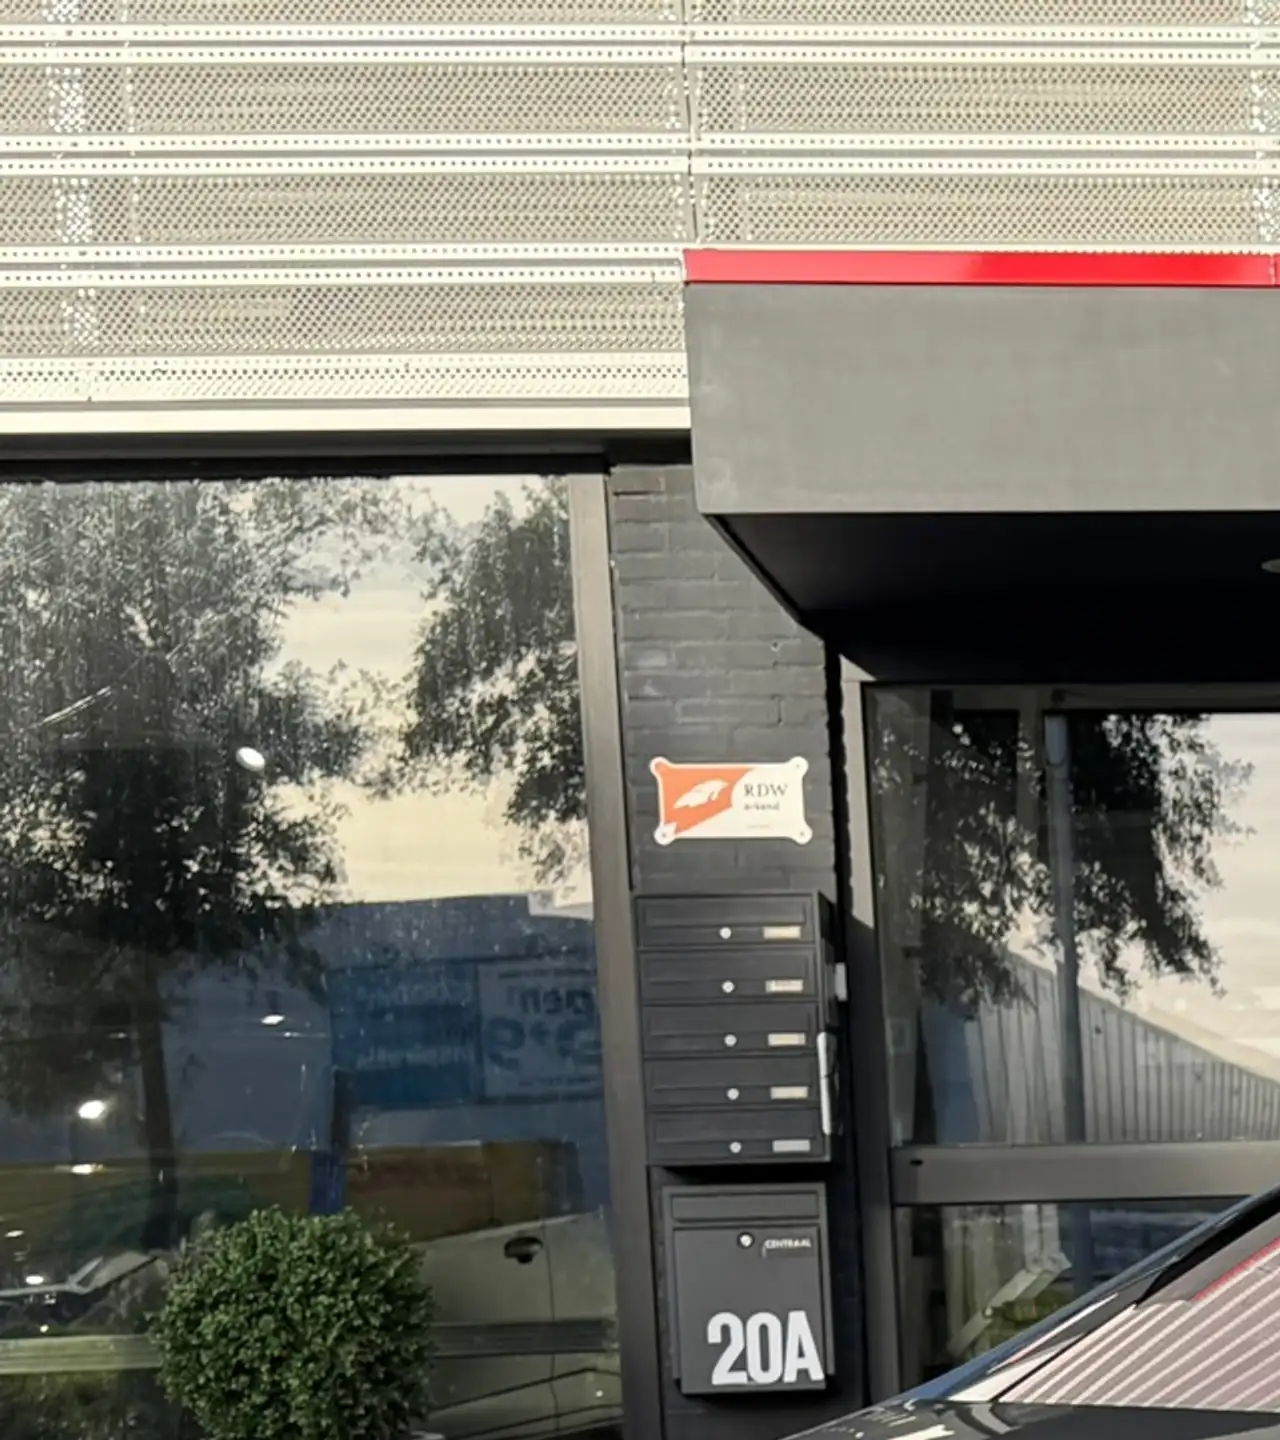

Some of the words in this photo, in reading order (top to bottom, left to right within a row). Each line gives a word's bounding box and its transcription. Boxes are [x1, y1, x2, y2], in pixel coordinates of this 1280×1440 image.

[744, 783, 789, 797] RDW
[764, 1238, 812, 1249] CENTRAAL
[707, 1310, 825, 1385] 20A
